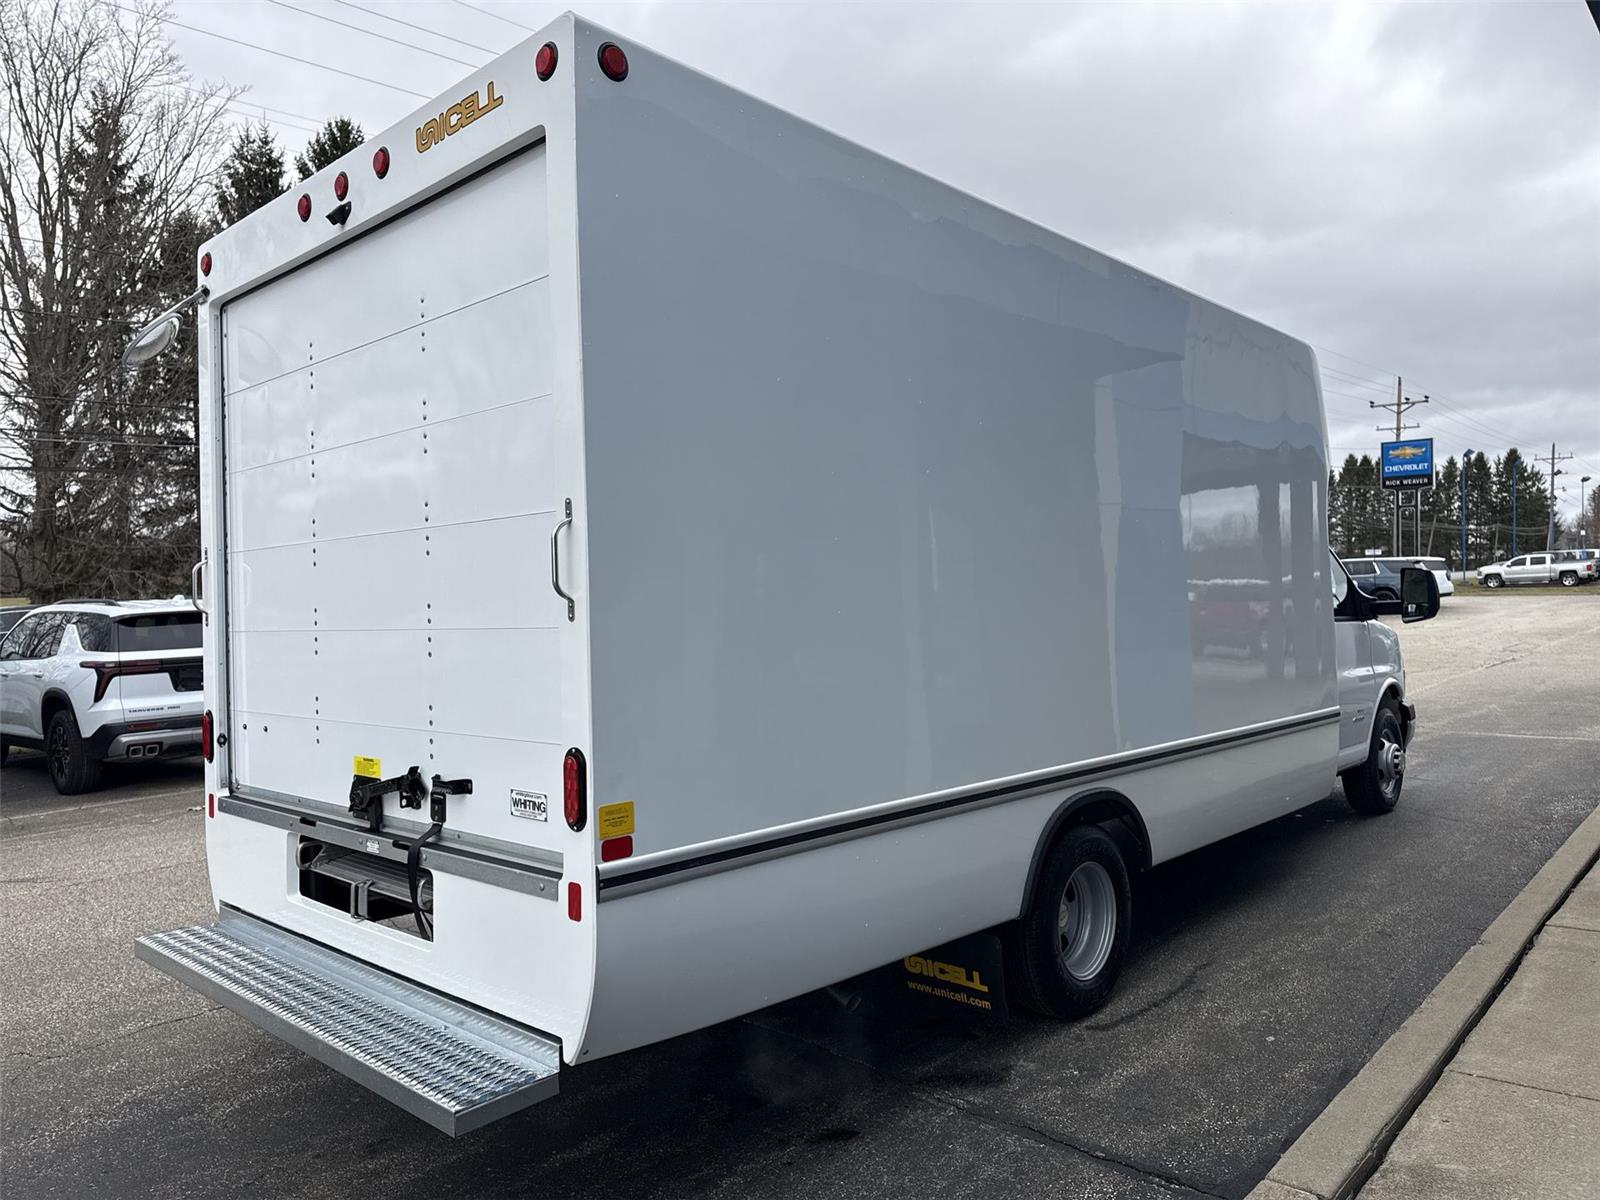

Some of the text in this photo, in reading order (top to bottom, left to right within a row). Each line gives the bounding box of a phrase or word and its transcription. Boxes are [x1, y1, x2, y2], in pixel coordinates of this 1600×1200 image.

[415, 80, 504, 154] UNICELL
[1384, 463, 1429, 473] CHEVROLET
[511, 797, 546, 813] WHITING
[904, 955, 989, 992] UNICELL
[907, 980, 992, 1010] www.unicell.com
